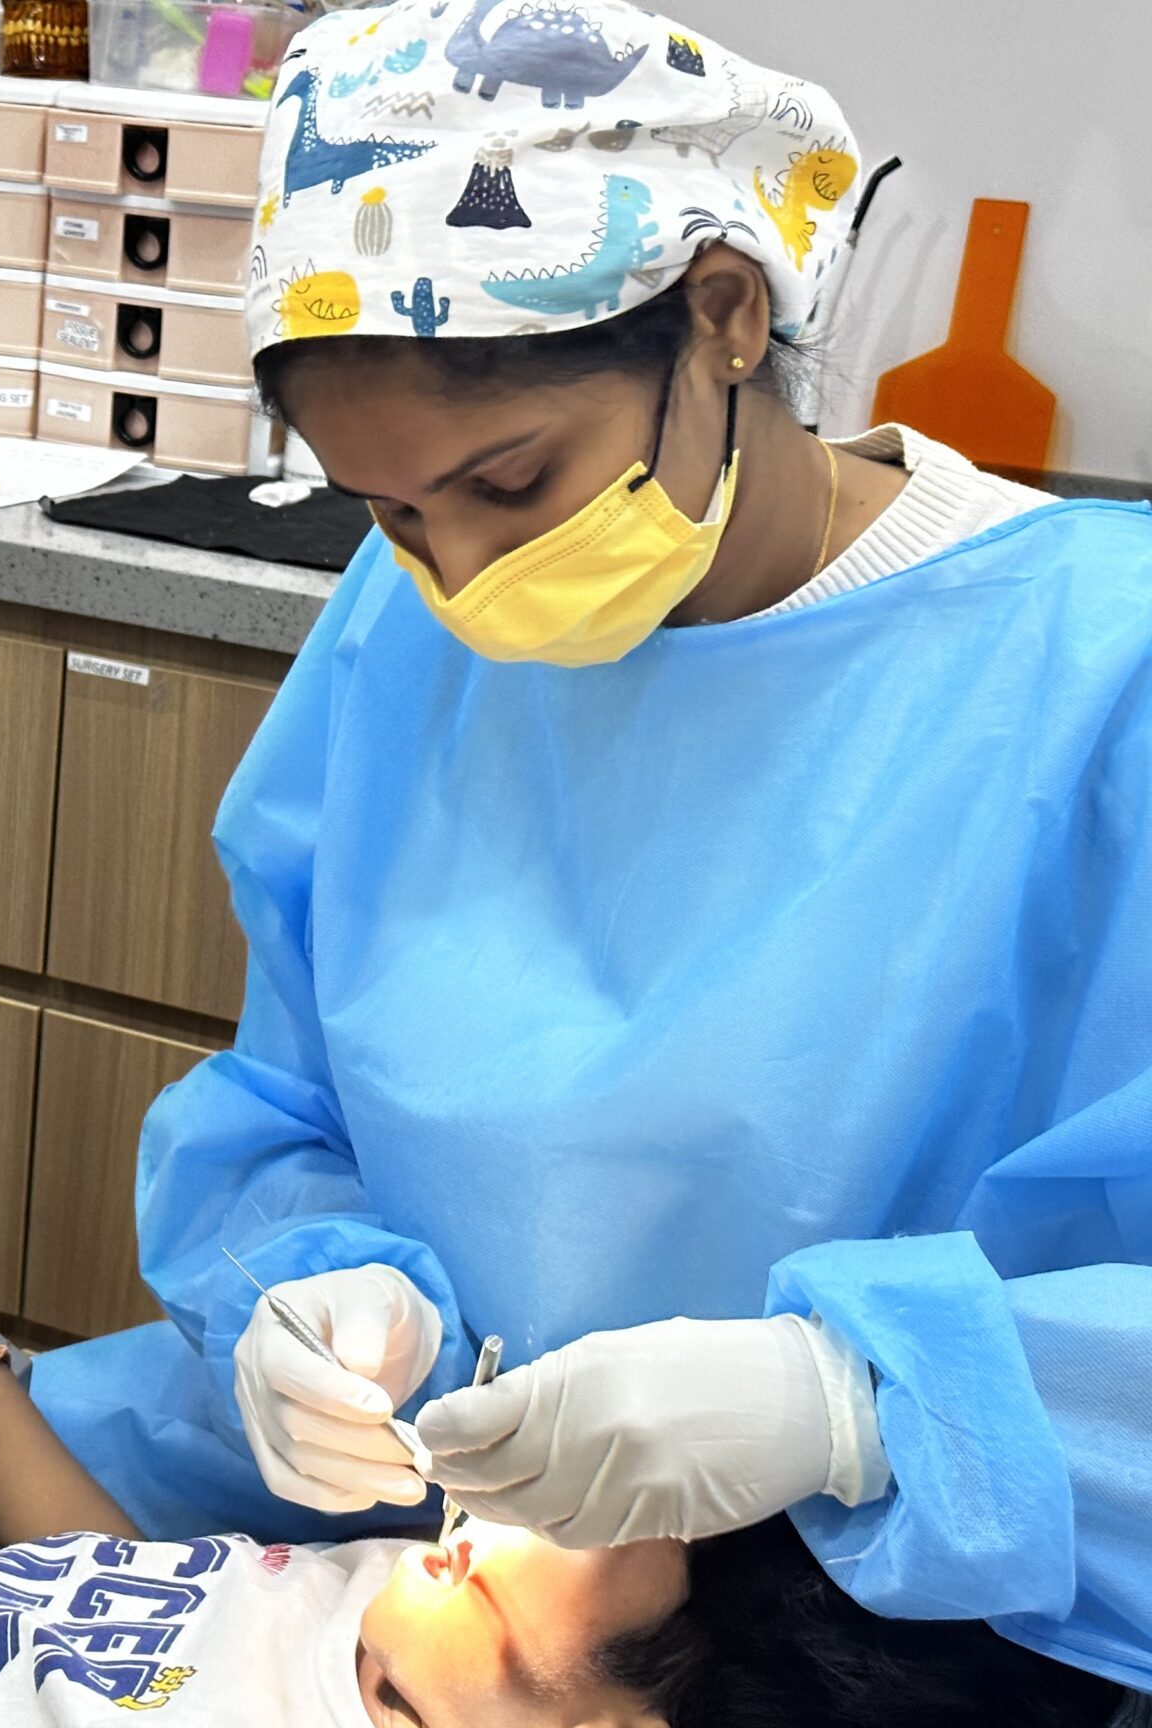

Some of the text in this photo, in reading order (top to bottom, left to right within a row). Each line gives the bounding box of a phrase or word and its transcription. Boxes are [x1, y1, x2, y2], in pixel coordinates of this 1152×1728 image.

[9, 392, 29, 404] SET
[72, 657, 143, 682] SURGERY SET
